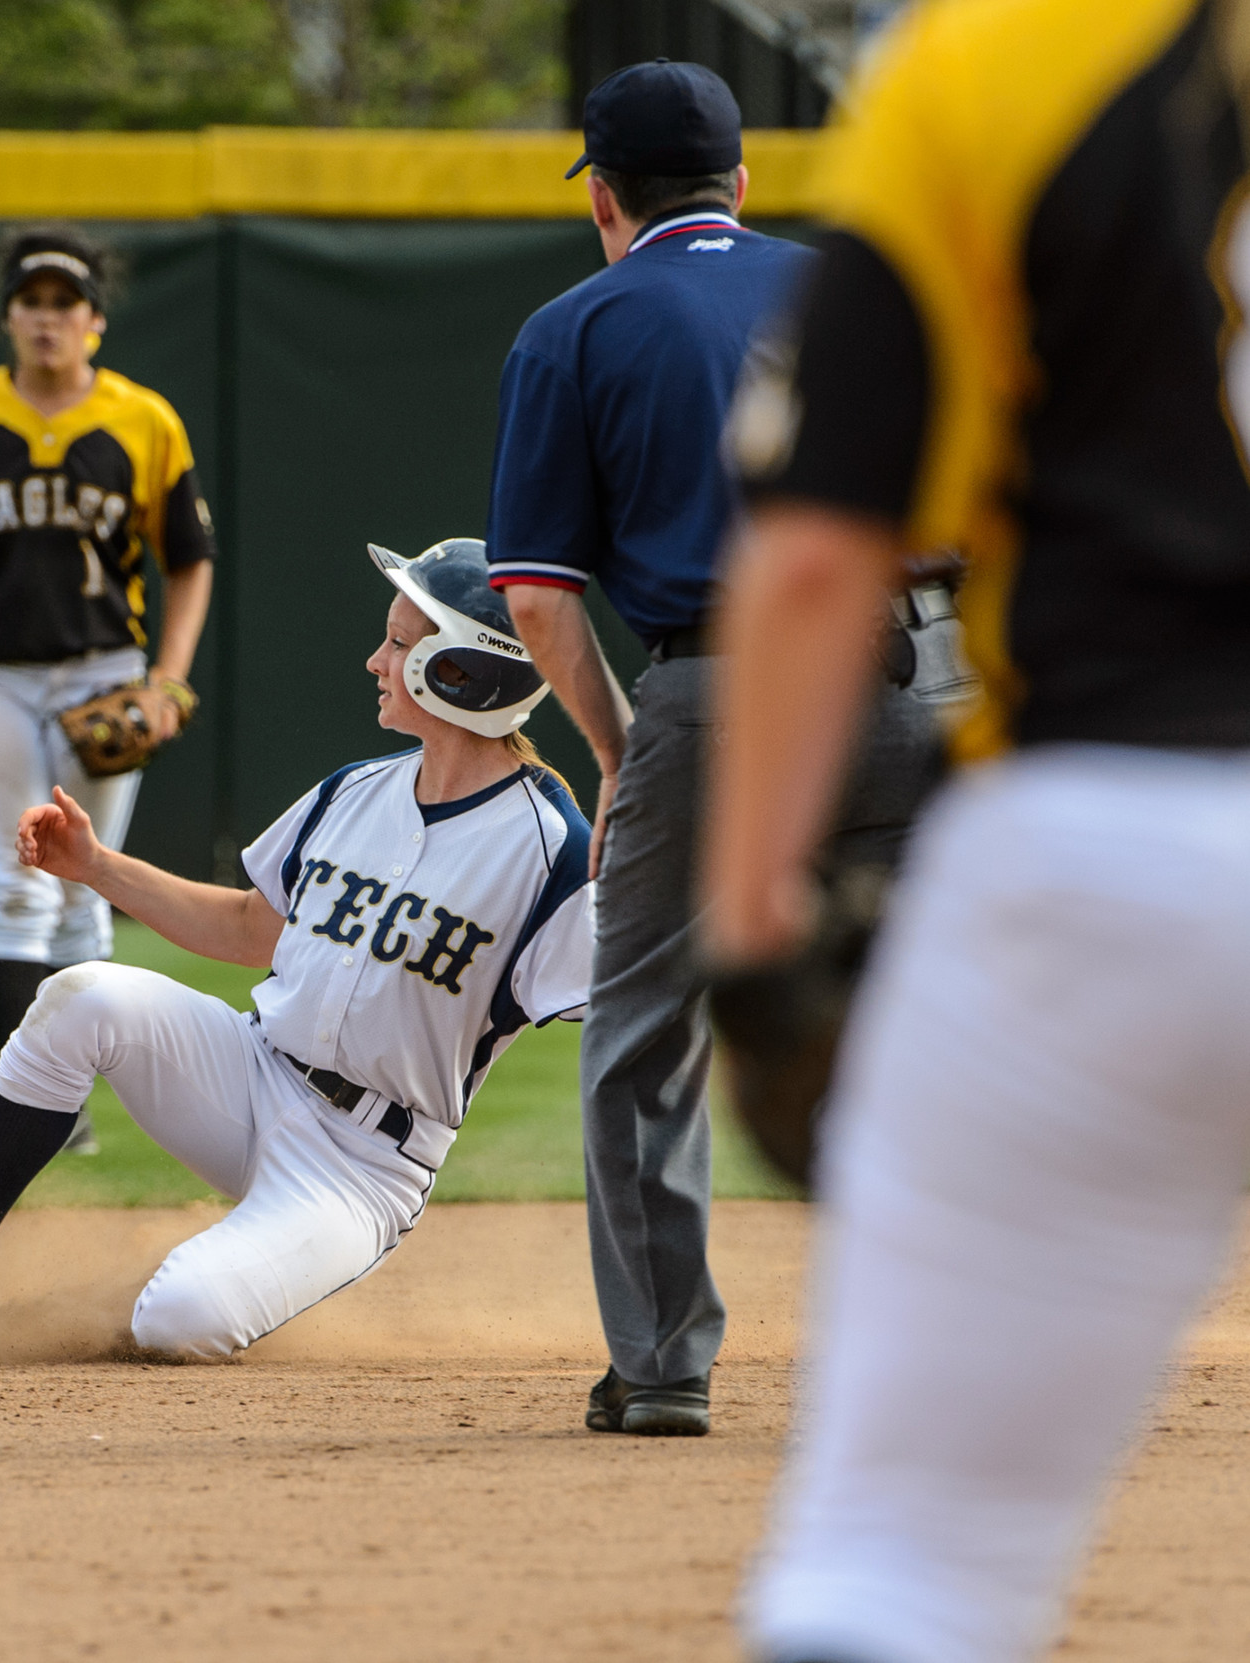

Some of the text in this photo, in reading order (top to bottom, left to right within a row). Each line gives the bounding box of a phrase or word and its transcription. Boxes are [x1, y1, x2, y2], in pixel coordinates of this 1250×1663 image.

[78, 536, 105, 598] 1
[487, 635, 525, 657] WORTH
[286, 857, 496, 997] TECH
